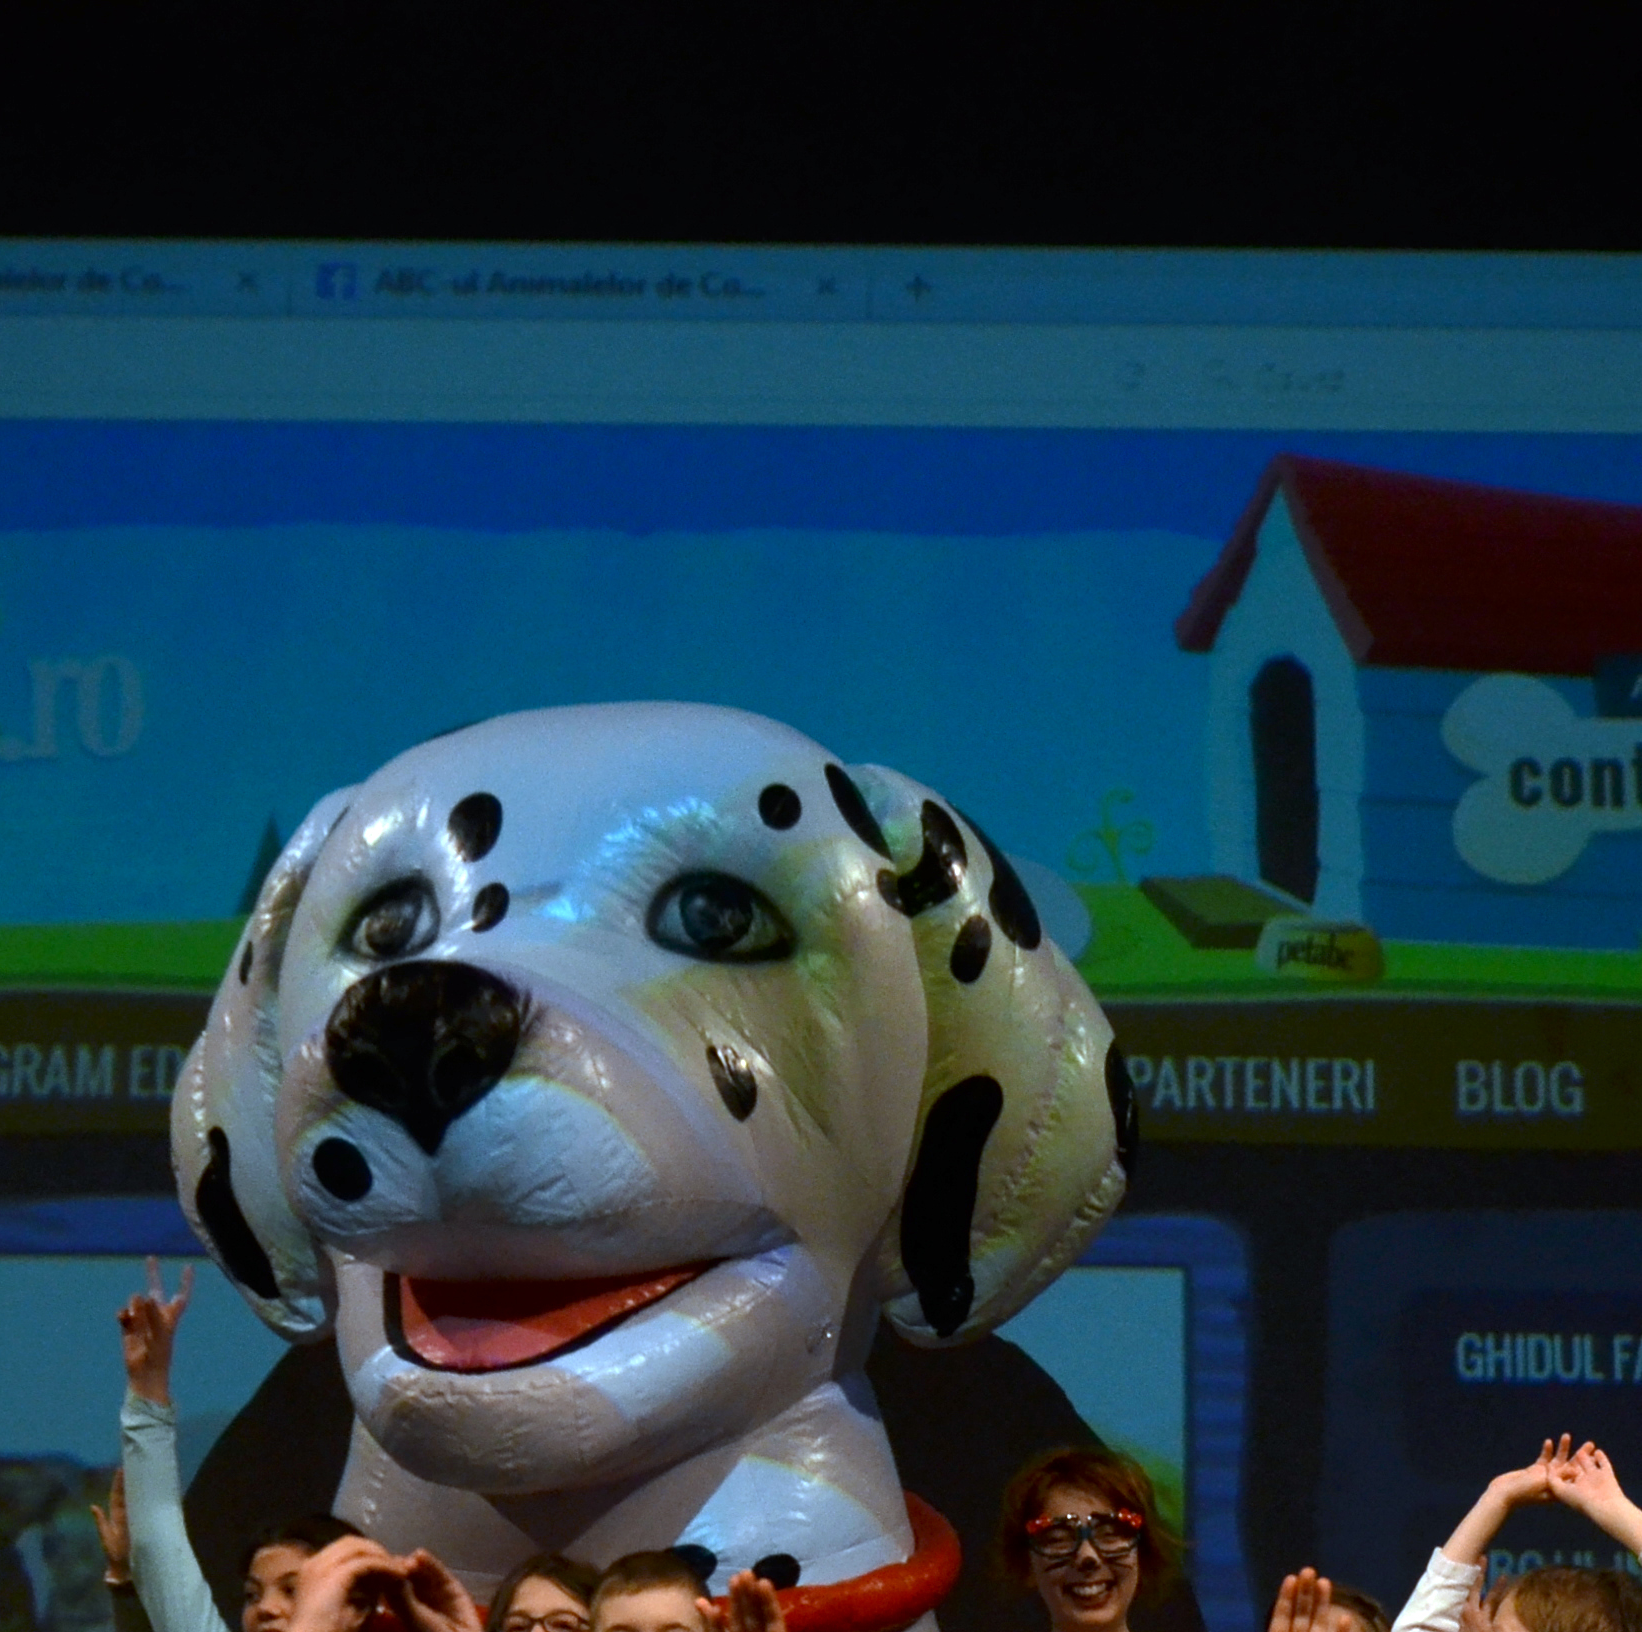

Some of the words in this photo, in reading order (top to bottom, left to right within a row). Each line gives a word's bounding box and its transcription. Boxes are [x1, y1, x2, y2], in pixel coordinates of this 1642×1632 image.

[129, 1043, 186, 1100] ED
[1126, 1054, 1376, 1113] PARTENERI
[1455, 1058, 1586, 1117] BLOG
[1457, 1331, 1606, 1383] GHIDUL
